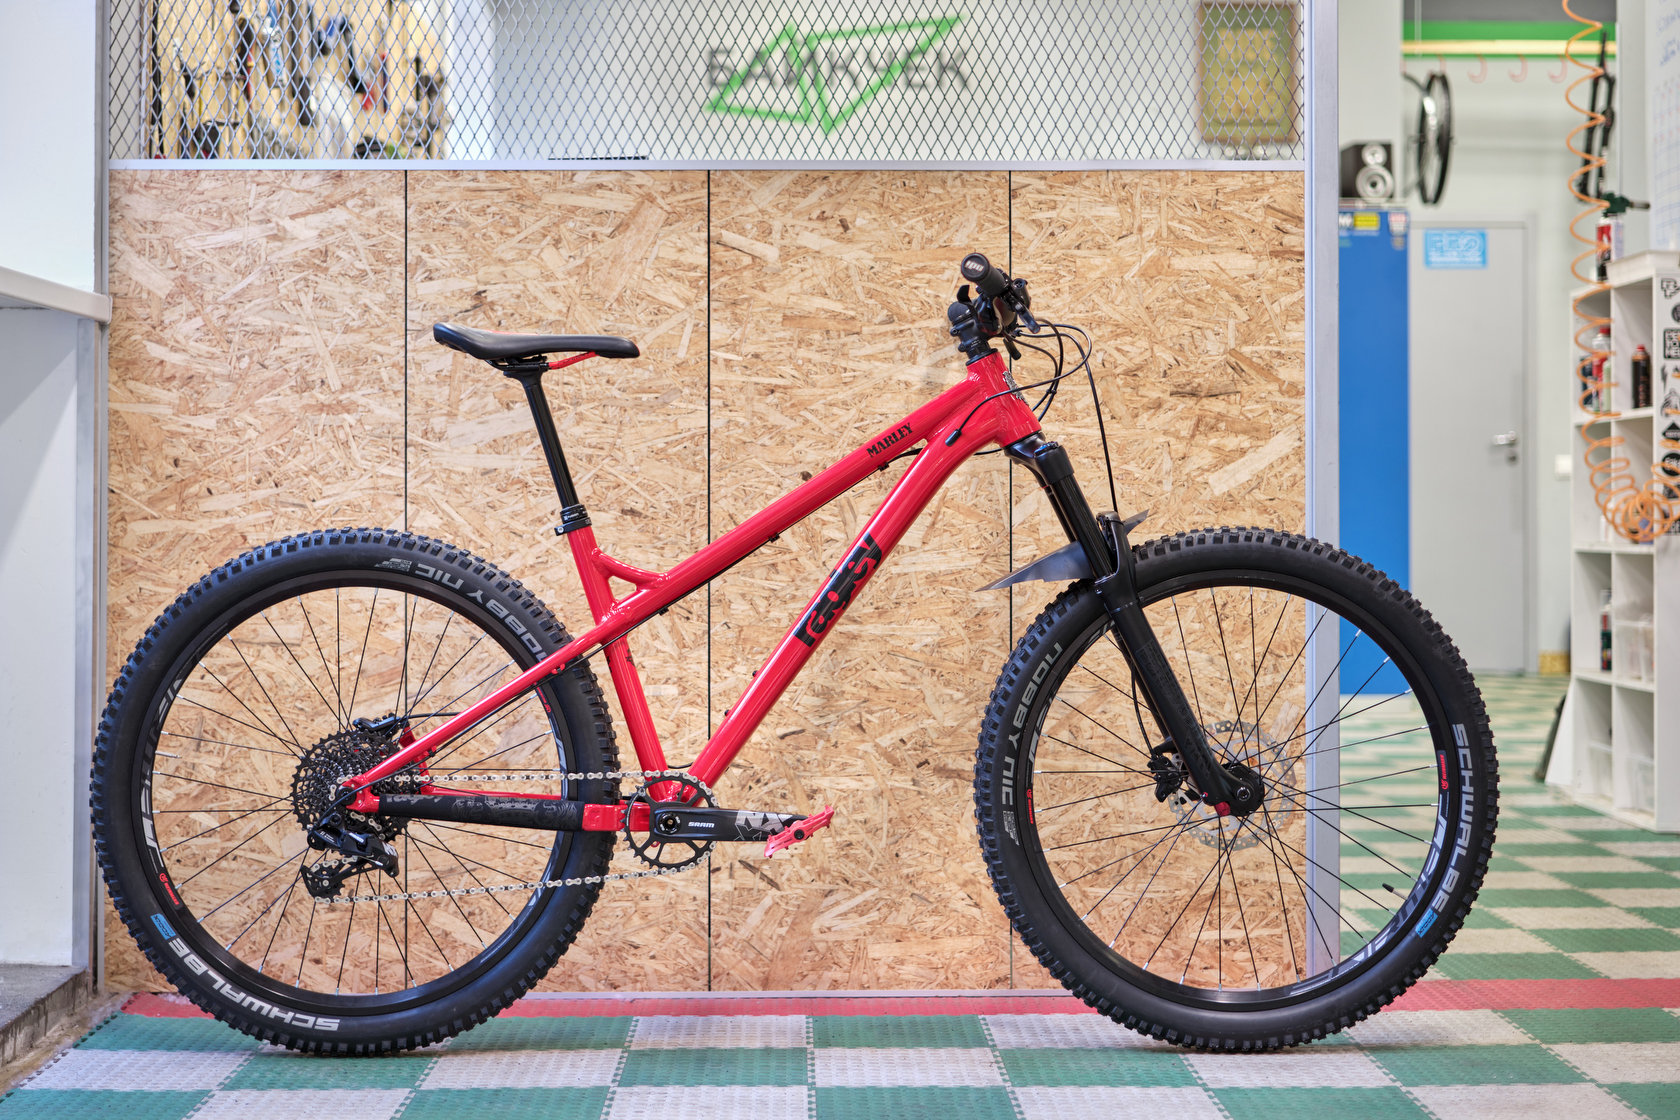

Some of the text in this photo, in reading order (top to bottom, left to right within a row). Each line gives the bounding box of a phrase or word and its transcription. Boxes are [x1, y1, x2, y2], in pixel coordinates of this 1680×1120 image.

[866, 422, 912, 458] MARLEY
[1008, 642, 1063, 750] NOBBY
[1432, 723, 1475, 913] SCHWALBE
[169, 937, 341, 1032] SCHWALBE
